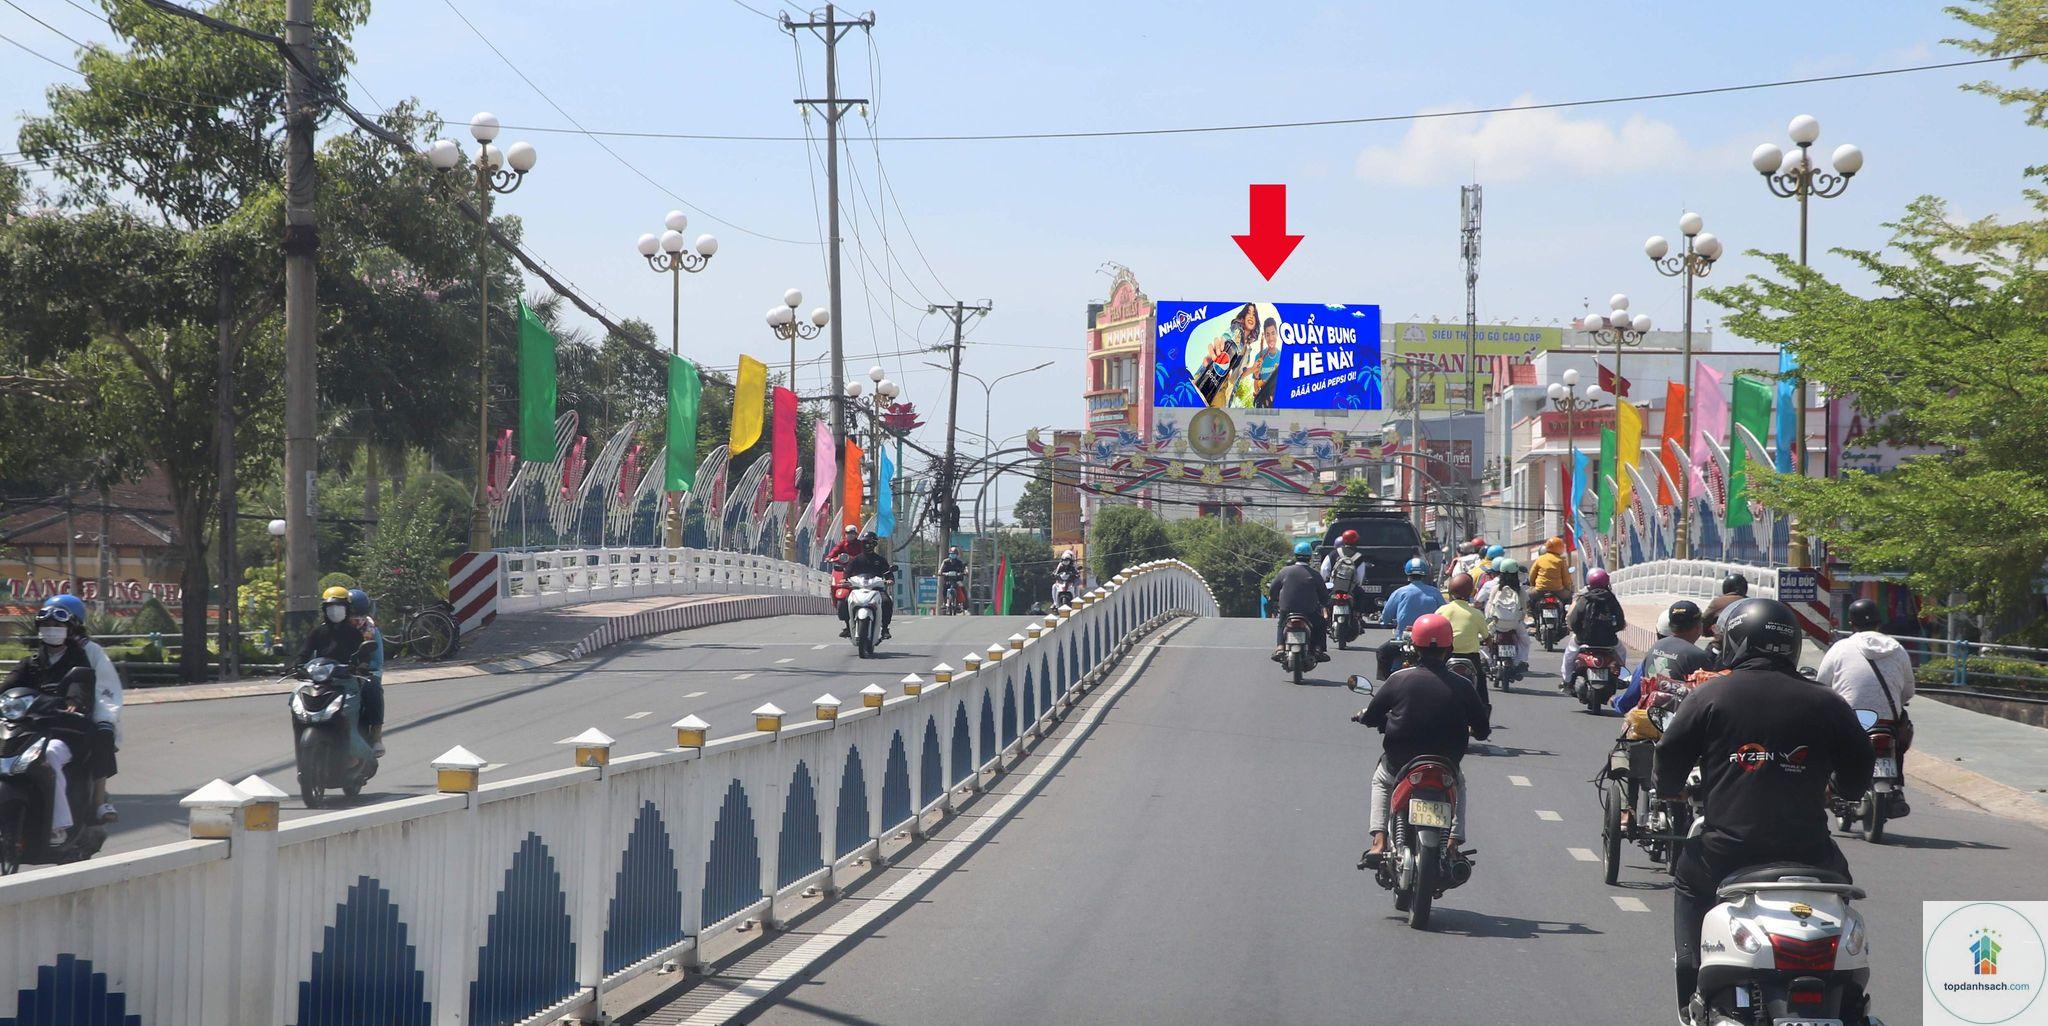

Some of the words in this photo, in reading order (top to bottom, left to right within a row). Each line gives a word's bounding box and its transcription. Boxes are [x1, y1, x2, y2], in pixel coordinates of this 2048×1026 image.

[1280, 313, 1325, 345] QUẨY
[1326, 326, 1357, 344] BUNG
[1292, 346, 1324, 379] HÈ
[1326, 346, 1354, 371] NÀY
[1327, 373, 1347, 389] PEPSI
[1729, 751, 1775, 763] RYZEN
